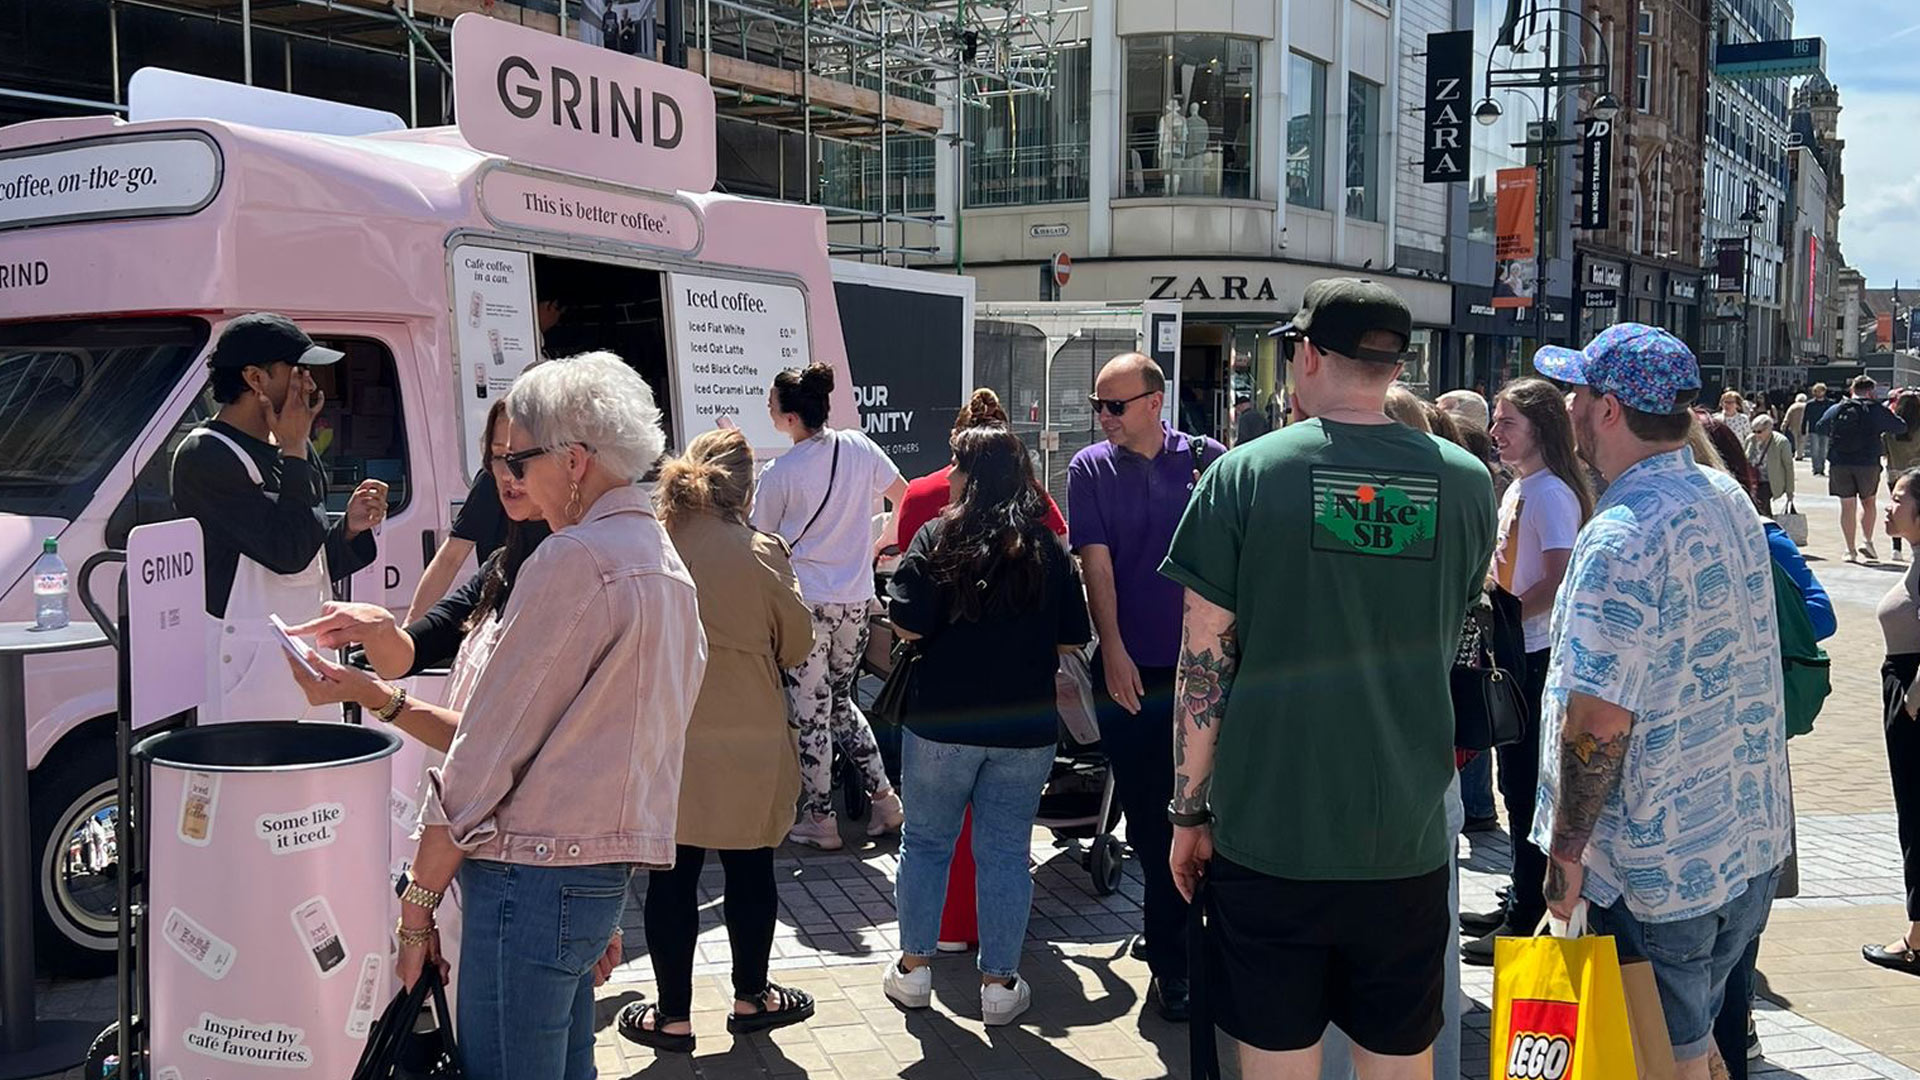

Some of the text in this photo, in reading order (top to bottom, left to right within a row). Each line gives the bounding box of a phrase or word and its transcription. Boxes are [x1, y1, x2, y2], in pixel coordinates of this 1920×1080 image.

[497, 55, 684, 150] GRIND
[1431, 78, 1462, 174] ZARA
[1587, 121, 1610, 138] JD
[58, 165, 157, 193] on-the-go.
[523, 192, 557, 215] This
[559, 198, 573, 217] is
[576, 201, 618, 225] better
[465, 258, 484, 269] Café
[474, 270, 484, 281] in
[485, 274, 491, 282] a
[687, 288, 767, 313] Iced coffee.
[1149, 276, 1279, 301] ZARA
[688, 321, 706, 333] Iced
[708, 322, 722, 334] Flat
[723, 324, 745, 335] White
[690, 342, 708, 353] Iced
[709, 343, 723, 354] Oat
[724, 344, 744, 355] Latte
[692, 363, 758, 376] Iced Black Coffee
[694, 384, 764, 395] Iced Caramel Latte
[696, 404, 739, 415] Iced Mocha
[892, 443, 919, 454] OTHERS
[1334, 494, 1418, 526] Nike
[1354, 522, 1394, 549] SB
[142, 551, 194, 585] GRIND
[262, 808, 340, 833] Some like
[277, 826, 331, 848] it iced.
[204, 1019, 298, 1048] Inspired by
[188, 1033, 308, 1062] café favourites.
[1508, 1034, 1569, 1080] LEGO
